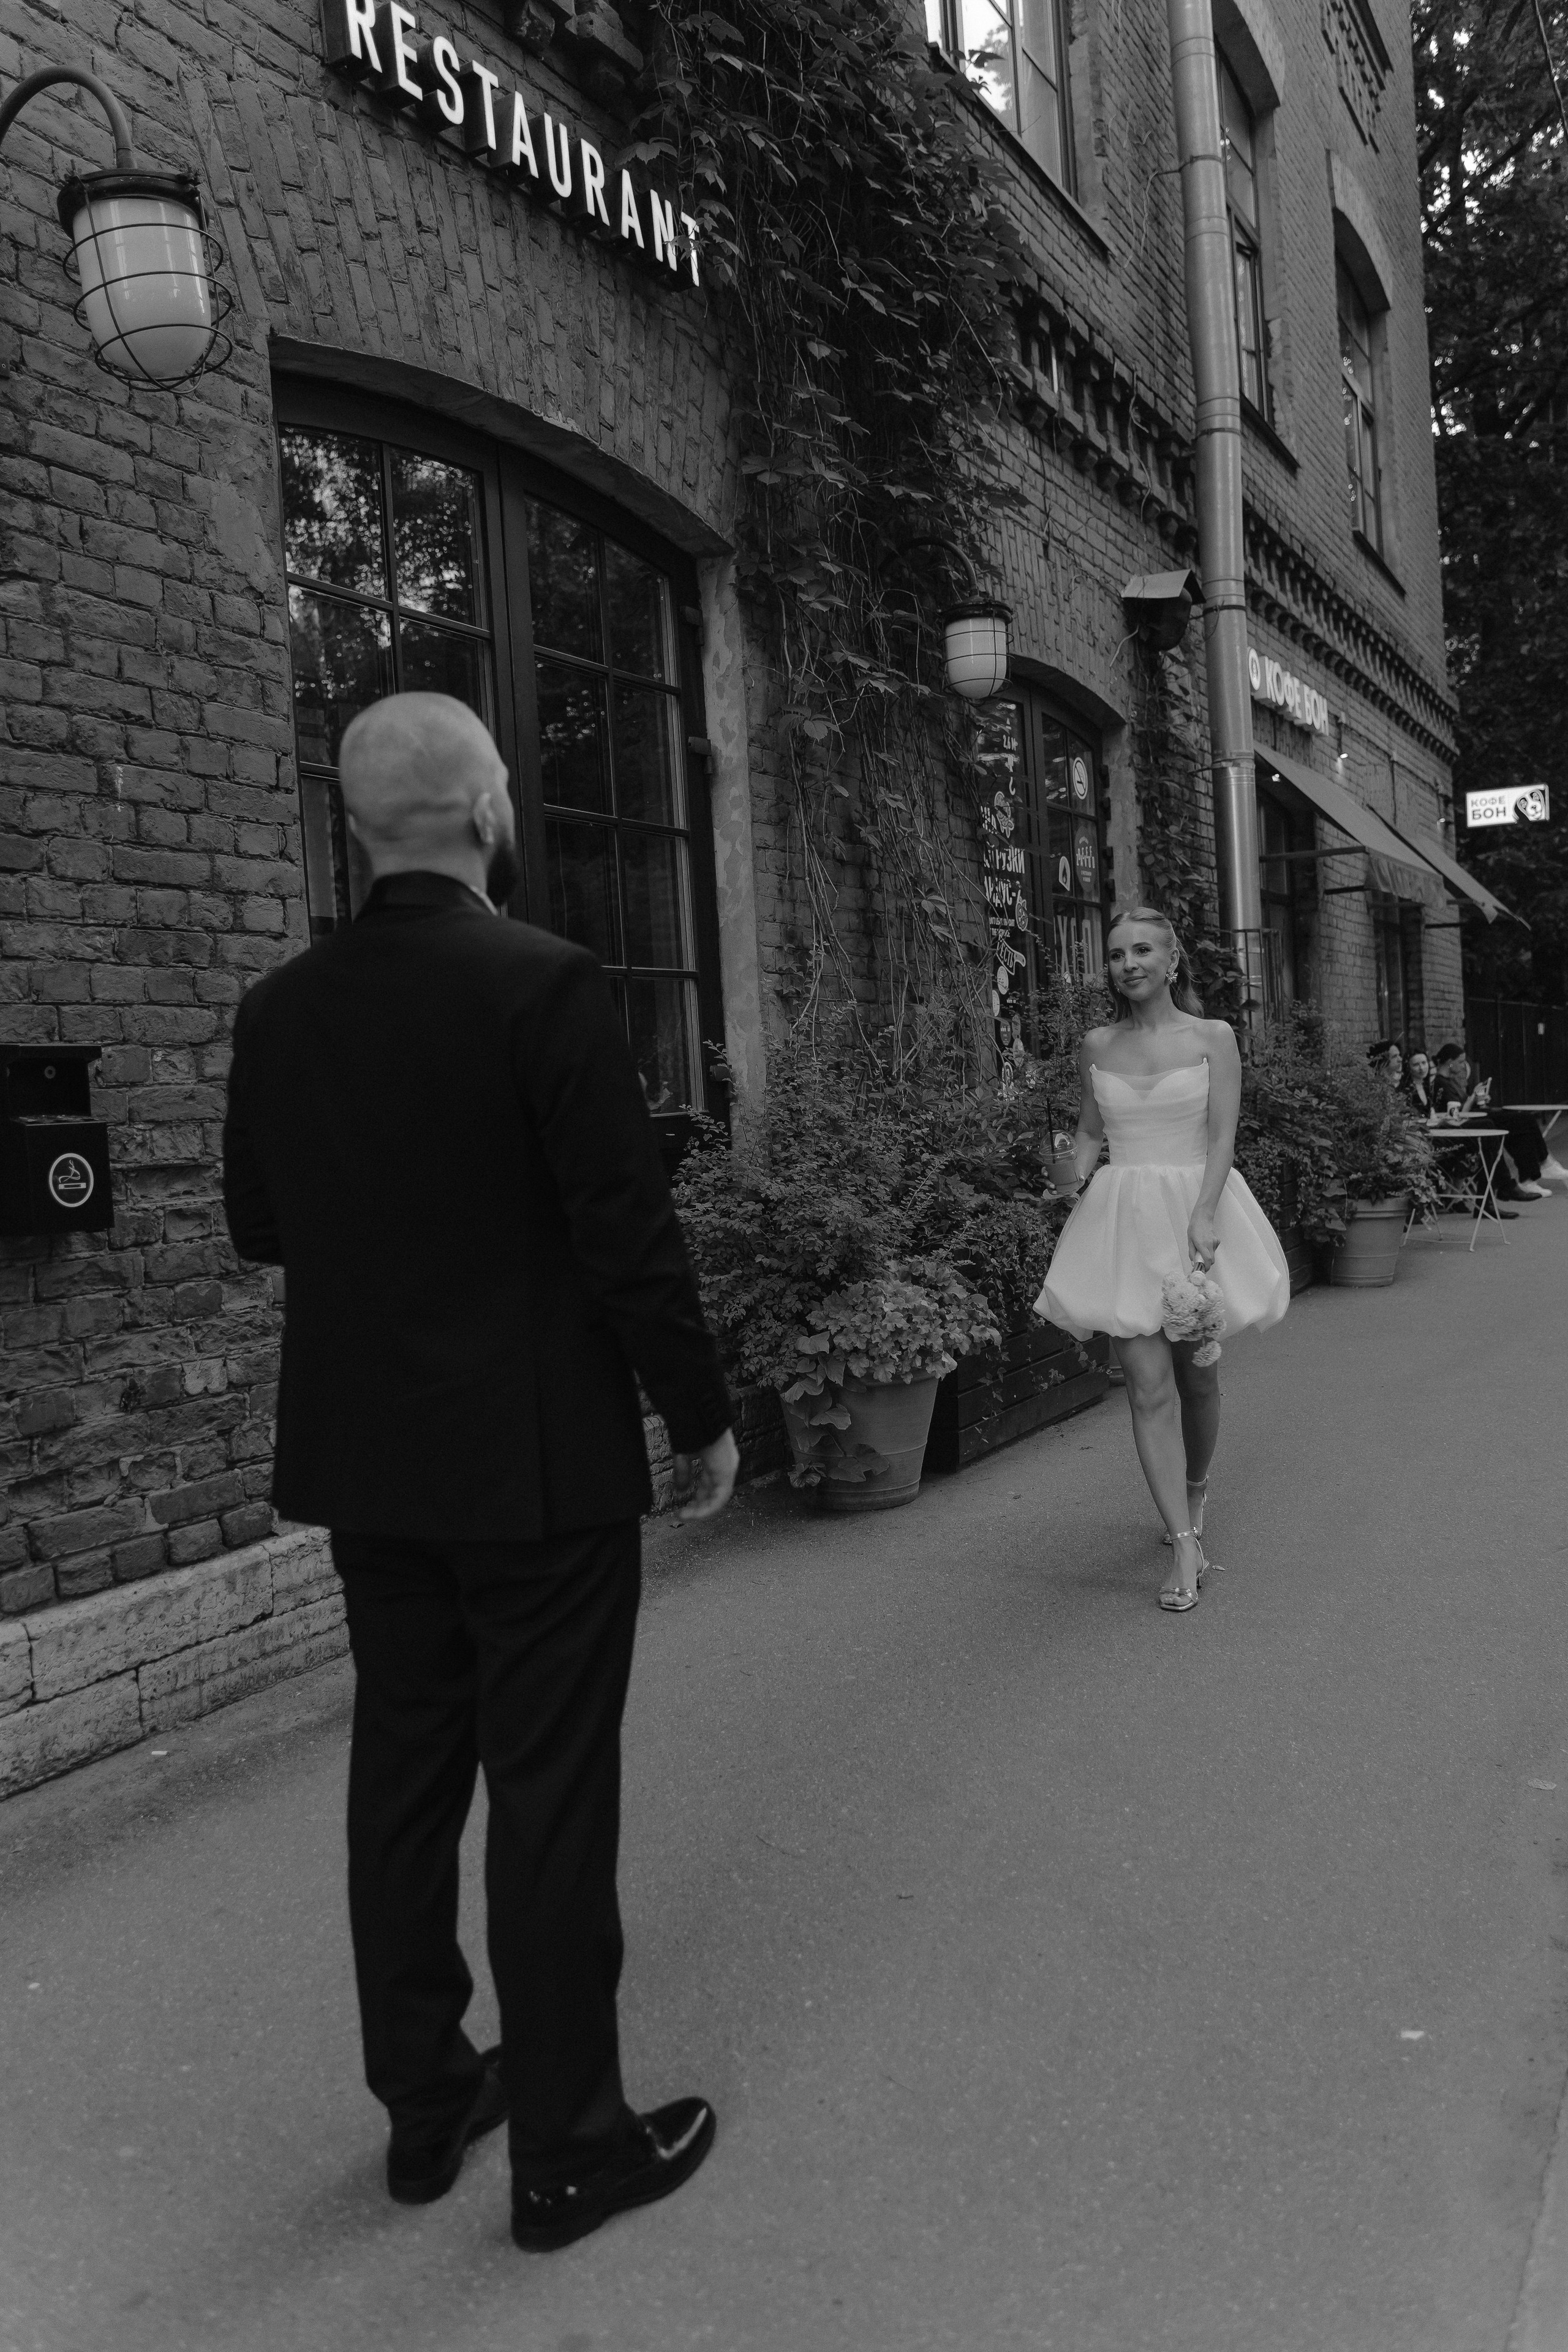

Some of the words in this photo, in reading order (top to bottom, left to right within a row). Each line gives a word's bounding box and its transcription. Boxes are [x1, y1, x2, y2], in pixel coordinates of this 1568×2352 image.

[346, 0, 699, 287] RESTAURANT
[1264, 655, 1302, 719] КОФЕ
[1303, 684, 1329, 736] БОН
[1471, 795, 1506, 807] КОФЕ
[1472, 807, 1506, 820] БОН
